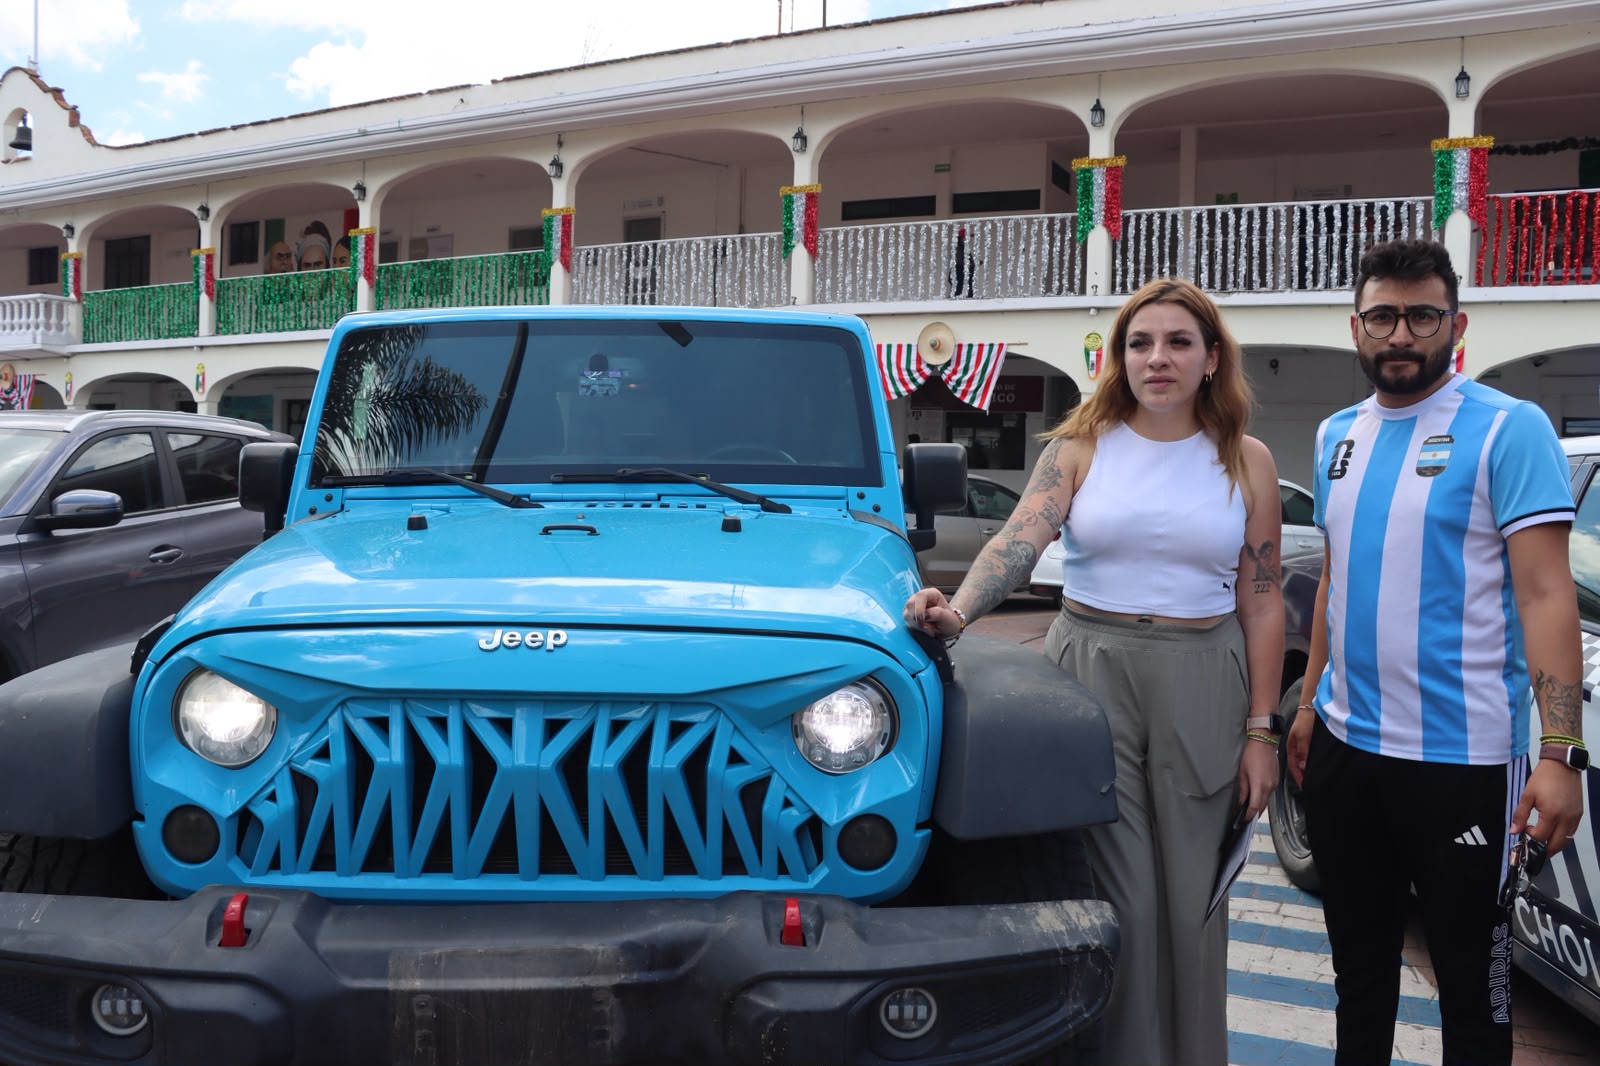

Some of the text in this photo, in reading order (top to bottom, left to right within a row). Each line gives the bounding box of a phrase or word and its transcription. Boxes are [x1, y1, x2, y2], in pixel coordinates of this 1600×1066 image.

[992, 392, 1016, 403] ICO
[478, 628, 568, 652] Jeep
[1489, 923, 1509, 1023] ADIDAS
